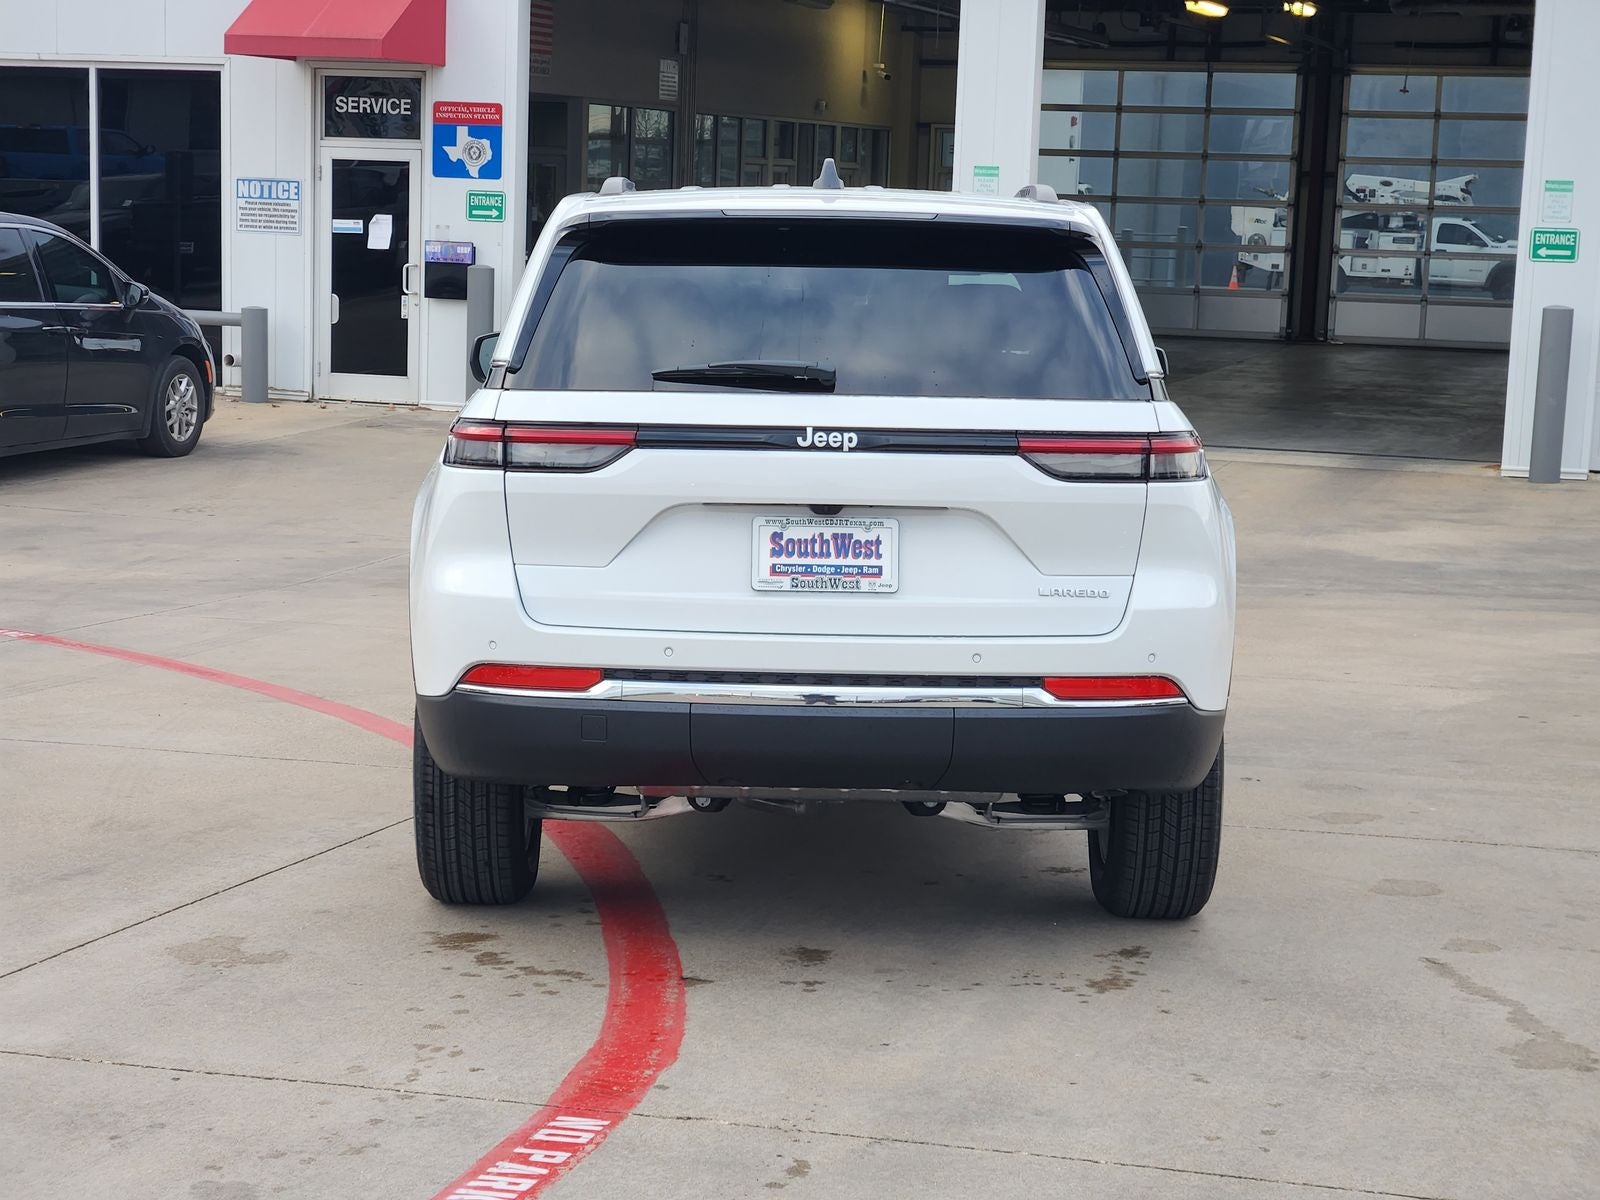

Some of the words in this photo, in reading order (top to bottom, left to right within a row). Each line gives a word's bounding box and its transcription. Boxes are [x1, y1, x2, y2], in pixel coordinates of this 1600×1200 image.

[335, 96, 411, 115] SERVICE
[238, 180, 299, 199] NOTICE
[470, 195, 502, 206] ENTRANCE
[1535, 233, 1575, 245] ENTRANCE
[796, 426, 858, 452] Jeep
[769, 531, 883, 560] SouthWest
[775, 564, 806, 574] Chrysler
[812, 565, 835, 574] Dodge
[841, 566, 858, 575] Jeep
[863, 566, 879, 574] Ram
[791, 577, 862, 590] SouthWest
[1038, 587, 1110, 599] LAREDO
[530, 1115, 612, 1144] NO
